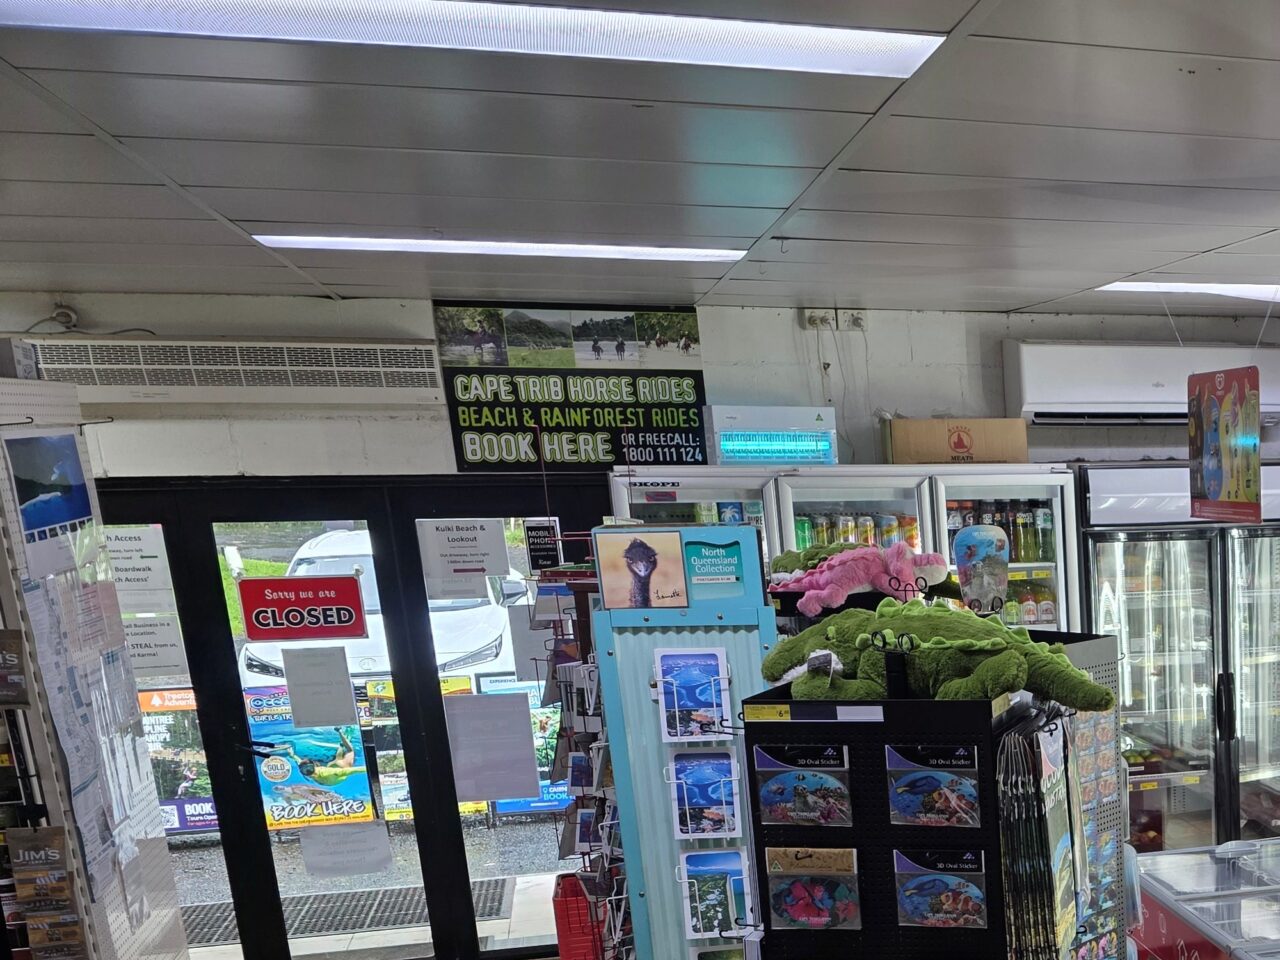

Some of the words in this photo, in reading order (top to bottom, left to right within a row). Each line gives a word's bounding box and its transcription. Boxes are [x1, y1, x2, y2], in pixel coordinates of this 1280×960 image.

[454, 374, 515, 402] CAPE
[514, 376, 565, 403] TRIB
[567, 376, 633, 403] HORSE
[636, 376, 696, 404] RIDES
[457, 406, 518, 427] BEACH
[523, 408, 535, 426] &
[540, 407, 645, 428] RAINFOREST
[652, 408, 700, 428] RIDES
[621, 433, 636, 446] OR
[638, 433, 700, 447] FREECALL:
[462, 431, 537, 463] BOOK
[541, 432, 615, 462] HERE
[622, 448, 654, 462] 1800
[658, 448, 677, 462] 111
[681, 448, 703, 462] 124
[435, 525, 455, 533] Kulki
[455, 524, 478, 532] Beach
[114, 534, 142, 542] Access
[447, 535, 478, 543] Lookout
[701, 547, 726, 556] North
[691, 556, 738, 566] Queensland
[114, 565, 152, 573] Boardwalk
[695, 564, 736, 573] Collection
[264, 588, 295, 601] Sorry
[299, 590, 314, 599] we
[318, 589, 337, 598] are
[252, 605, 356, 629] CLOSED
[133, 621, 159, 629] Business
[131, 642, 154, 650] STEAL
[164, 692, 196, 701] Treetop
[543, 792, 569, 800] BOOK
[184, 802, 214, 816] BOOK
[271, 803, 320, 822] BOOK
[322, 799, 366, 816] HERE
[13, 847, 61, 864] JIM'S
